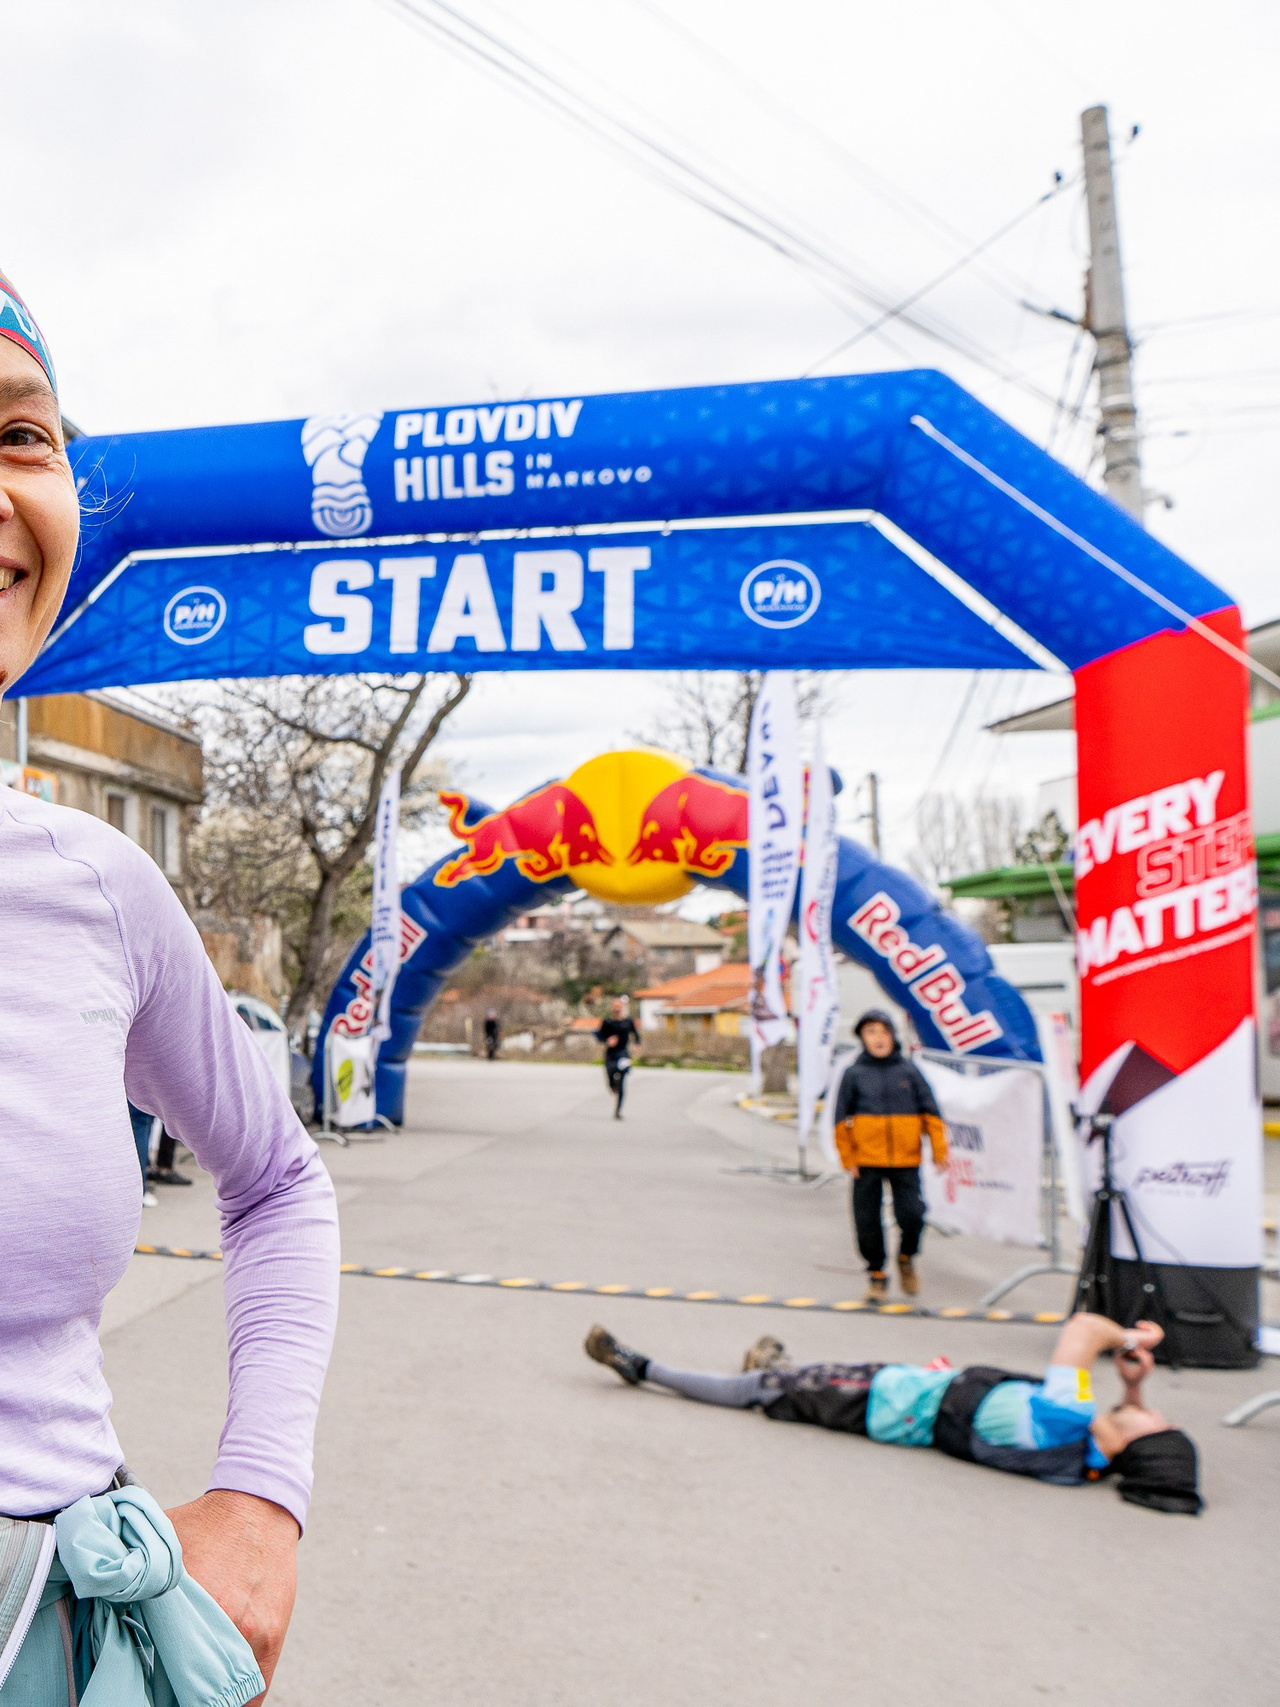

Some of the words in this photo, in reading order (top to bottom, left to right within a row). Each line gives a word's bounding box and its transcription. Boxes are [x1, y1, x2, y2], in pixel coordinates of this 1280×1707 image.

[394, 400, 584, 450] PLOVDIV
[394, 450, 515, 502] HILLS
[526, 453, 553, 470] IN
[526, 466, 653, 490] MARKOVO
[303, 546, 652, 655] START
[1075, 769, 1226, 882] EVERY
[855, 900, 937, 976] Red
[919, 970, 994, 1047] Bull
[333, 974, 371, 1035] Red
